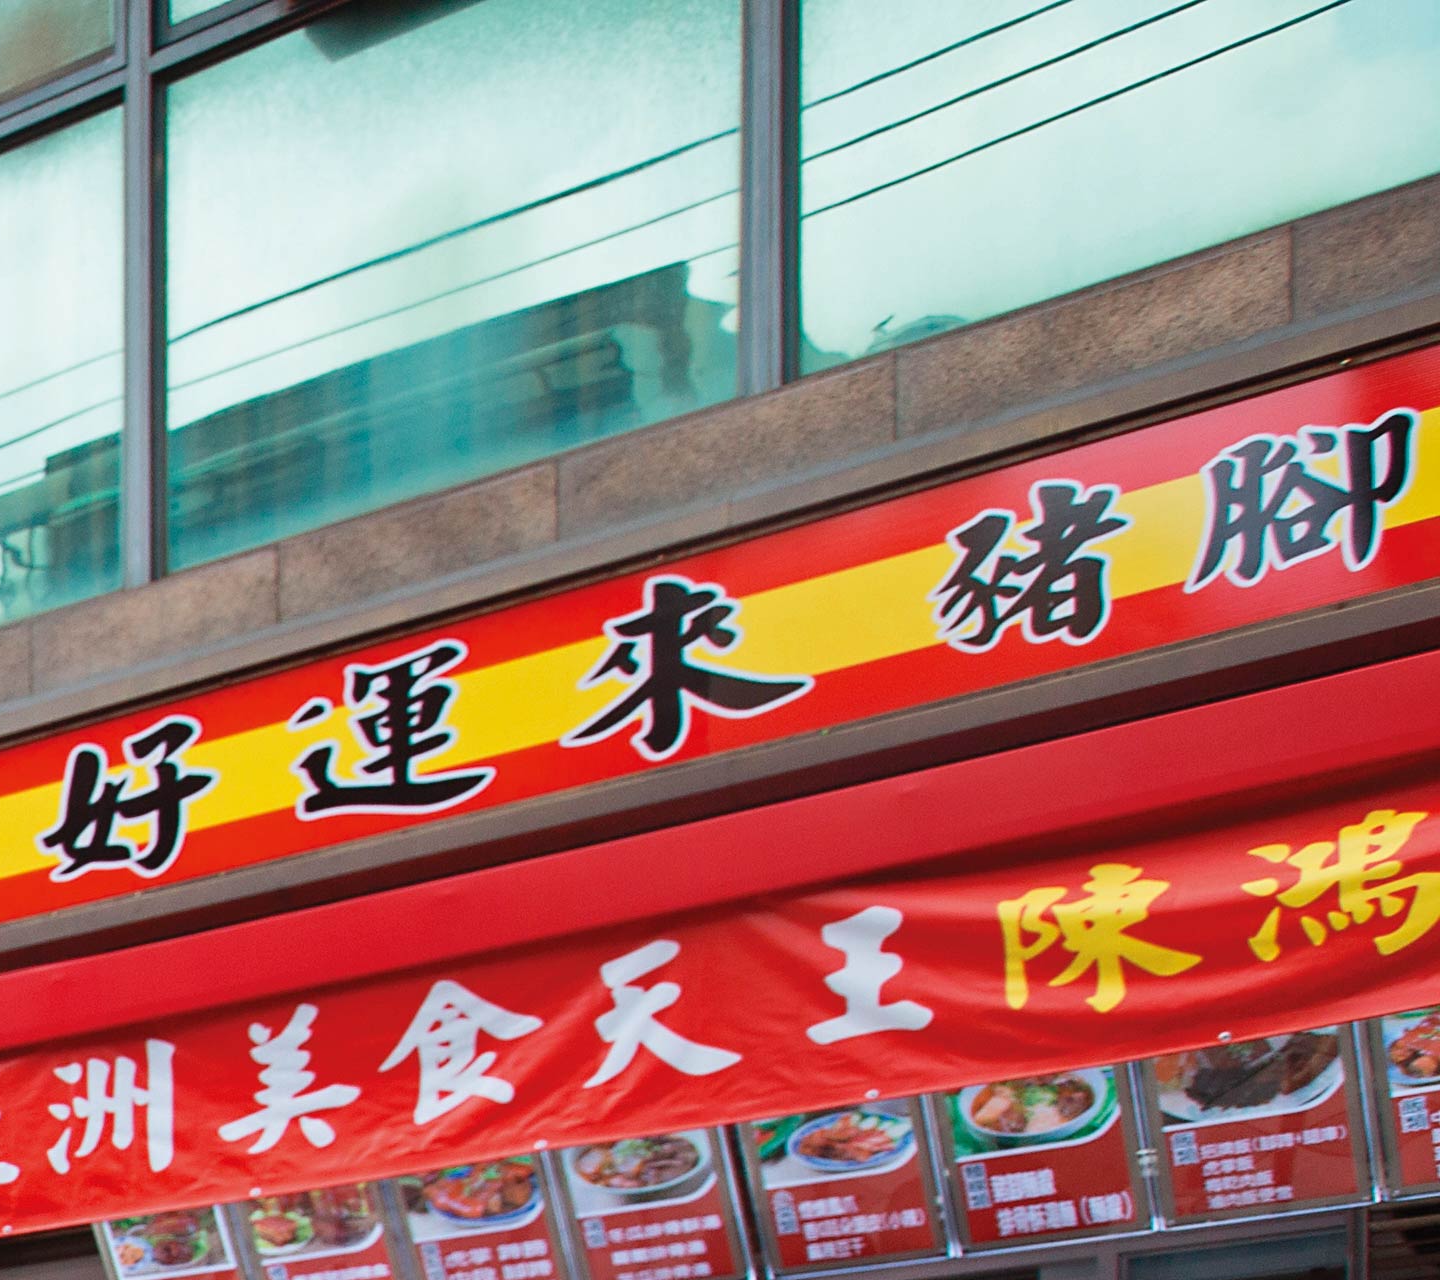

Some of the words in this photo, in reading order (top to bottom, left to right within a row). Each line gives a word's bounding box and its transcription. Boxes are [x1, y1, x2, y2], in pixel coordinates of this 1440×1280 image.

[38, 407, 1421, 882] 好運來豬腳
